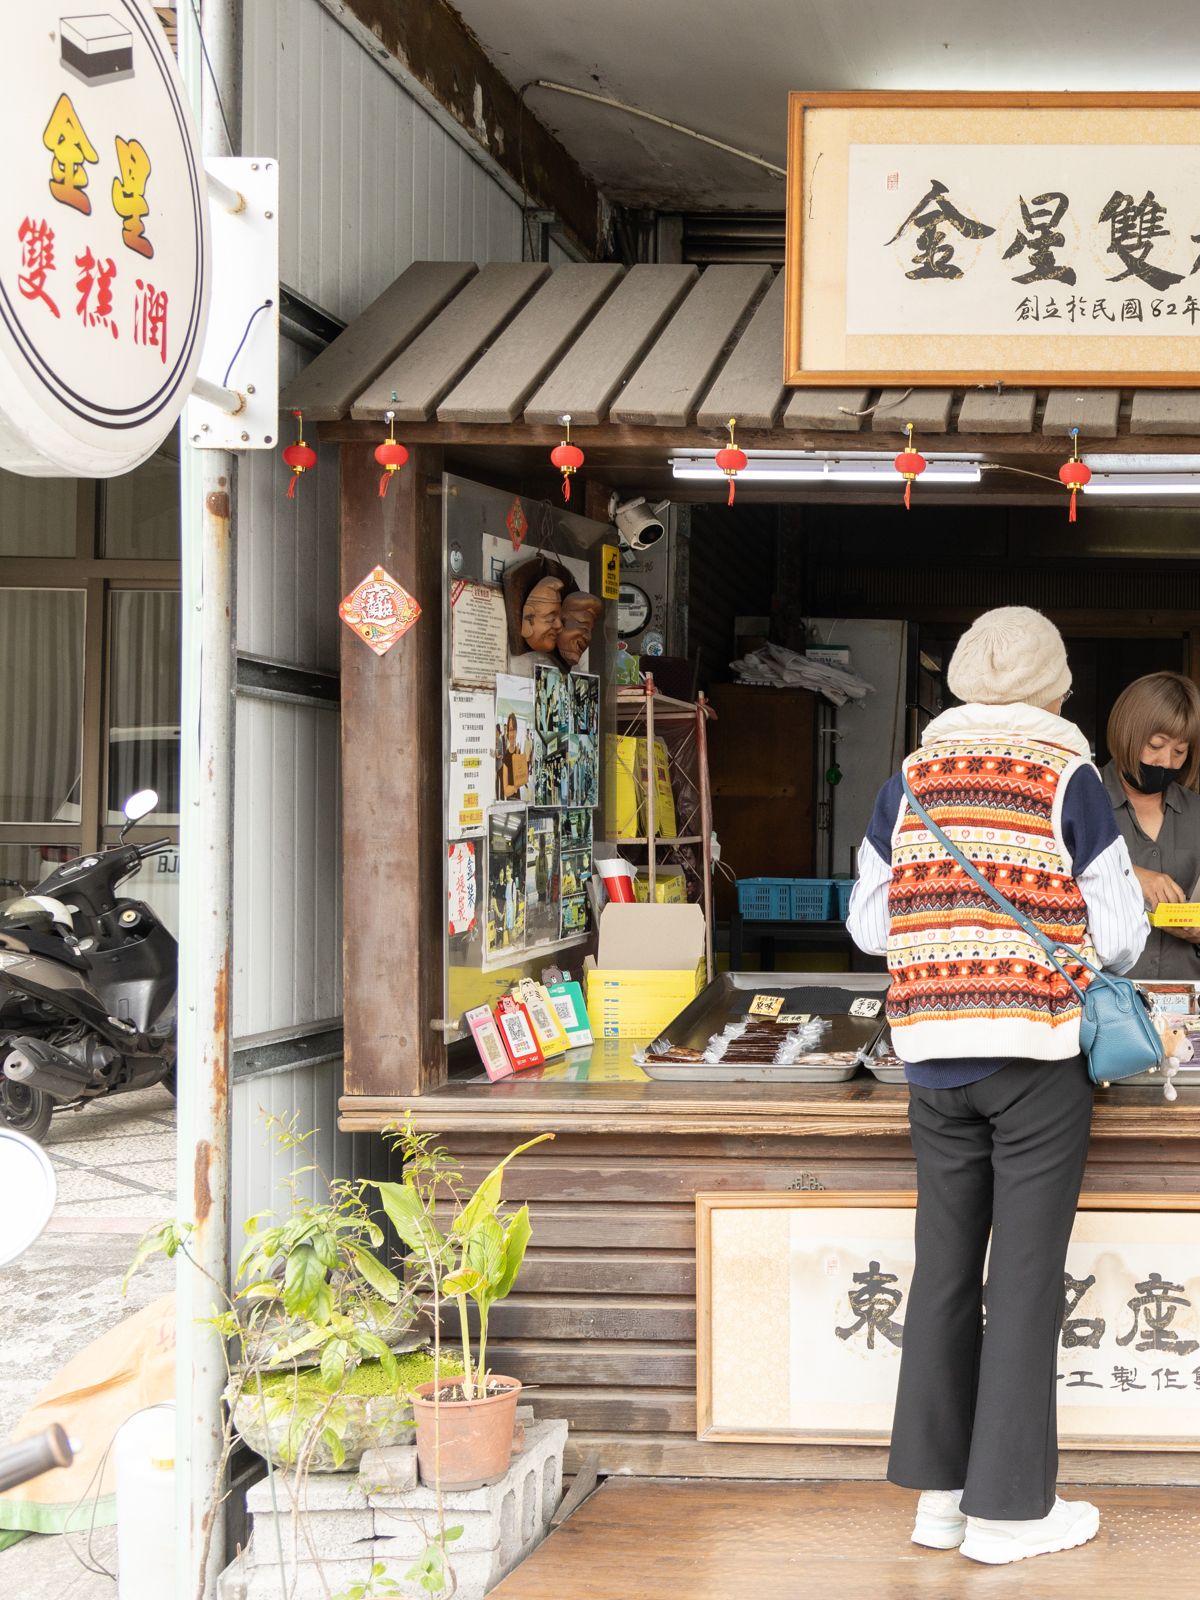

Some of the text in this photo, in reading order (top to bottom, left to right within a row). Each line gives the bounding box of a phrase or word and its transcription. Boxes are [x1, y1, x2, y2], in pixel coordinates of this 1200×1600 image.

[43, 93, 154, 259] 金星
[18, 216, 168, 364] 雙糕潤
[157, 855, 180, 873] BJ
